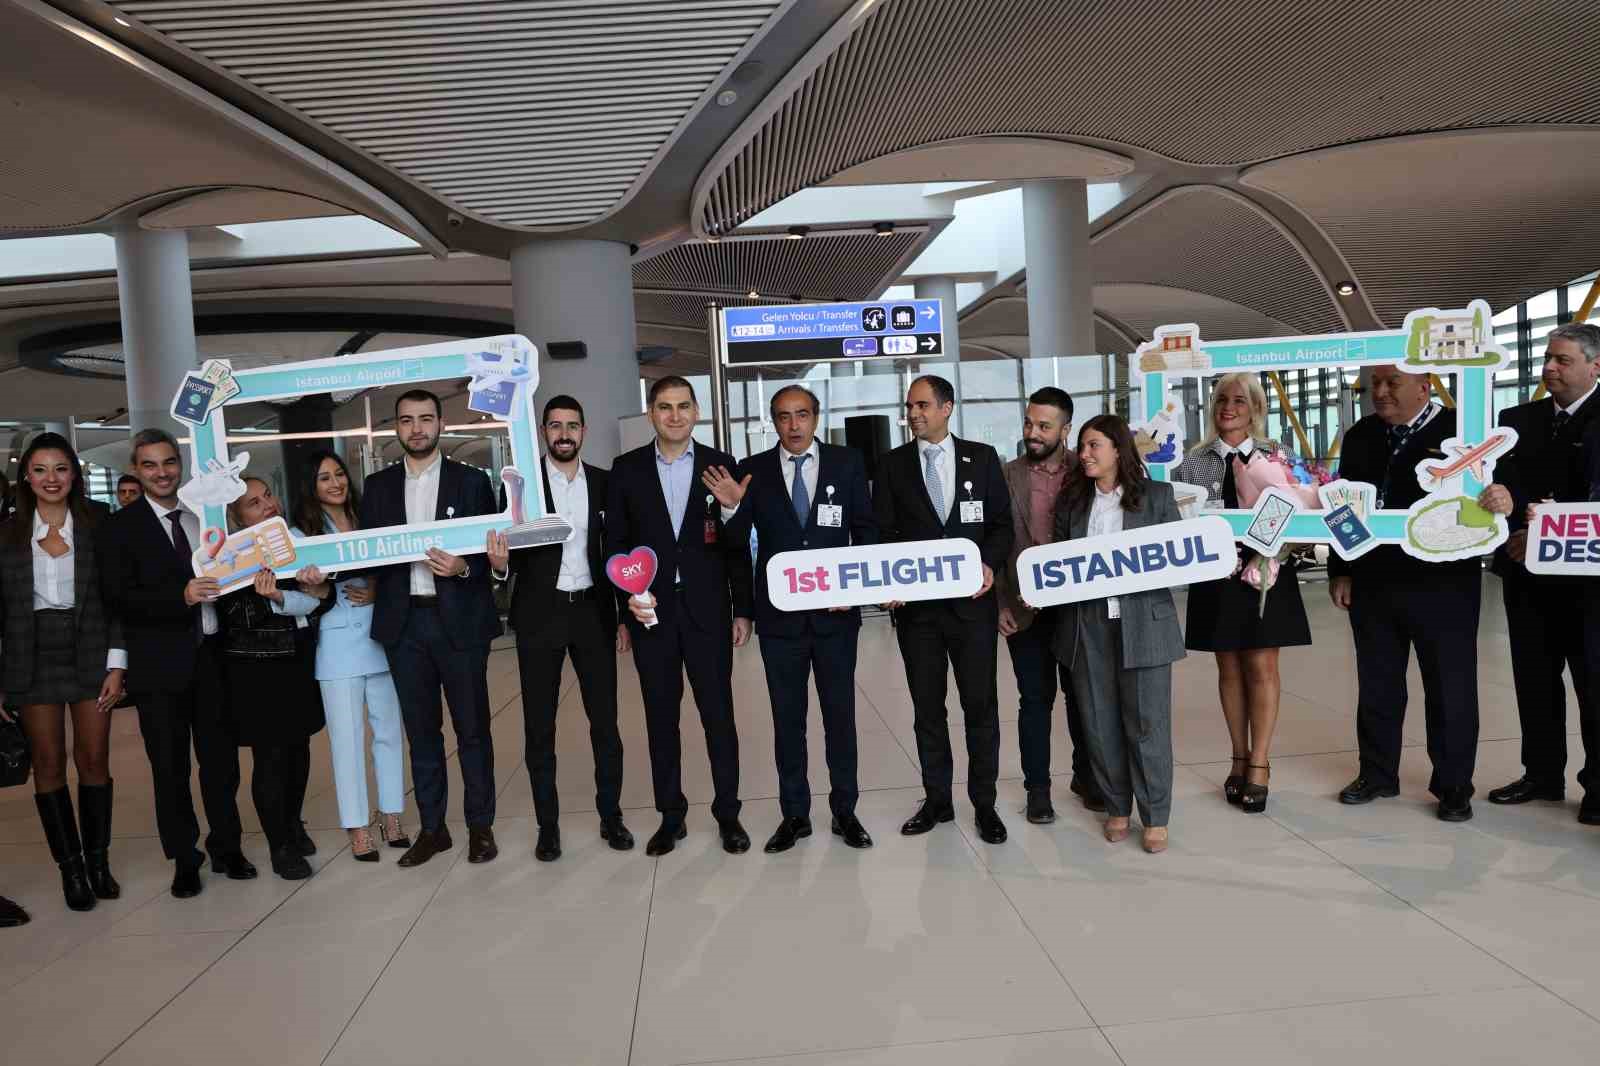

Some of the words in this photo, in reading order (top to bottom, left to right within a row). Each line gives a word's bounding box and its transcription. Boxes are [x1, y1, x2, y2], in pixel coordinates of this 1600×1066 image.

[762, 312, 789, 322] Gelen
[790, 311, 815, 321] Yolcu
[822, 309, 857, 320] Transfer
[777, 324, 811, 335] Arrivals
[819, 322, 859, 333] Transfers
[1235, 350, 1291, 363] Istanbul
[1295, 344, 1345, 362] Airport
[295, 371, 352, 388] Istanbul
[356, 364, 406, 384] Airport
[1541, 513, 1600, 537] NE
[335, 540, 369, 562] 110
[376, 533, 445, 558] Airlines
[622, 561, 642, 577] SKY
[783, 566, 831, 594] 1st
[838, 554, 966, 590] FLIGHT
[1032, 535, 1220, 590] ISTANBUL
